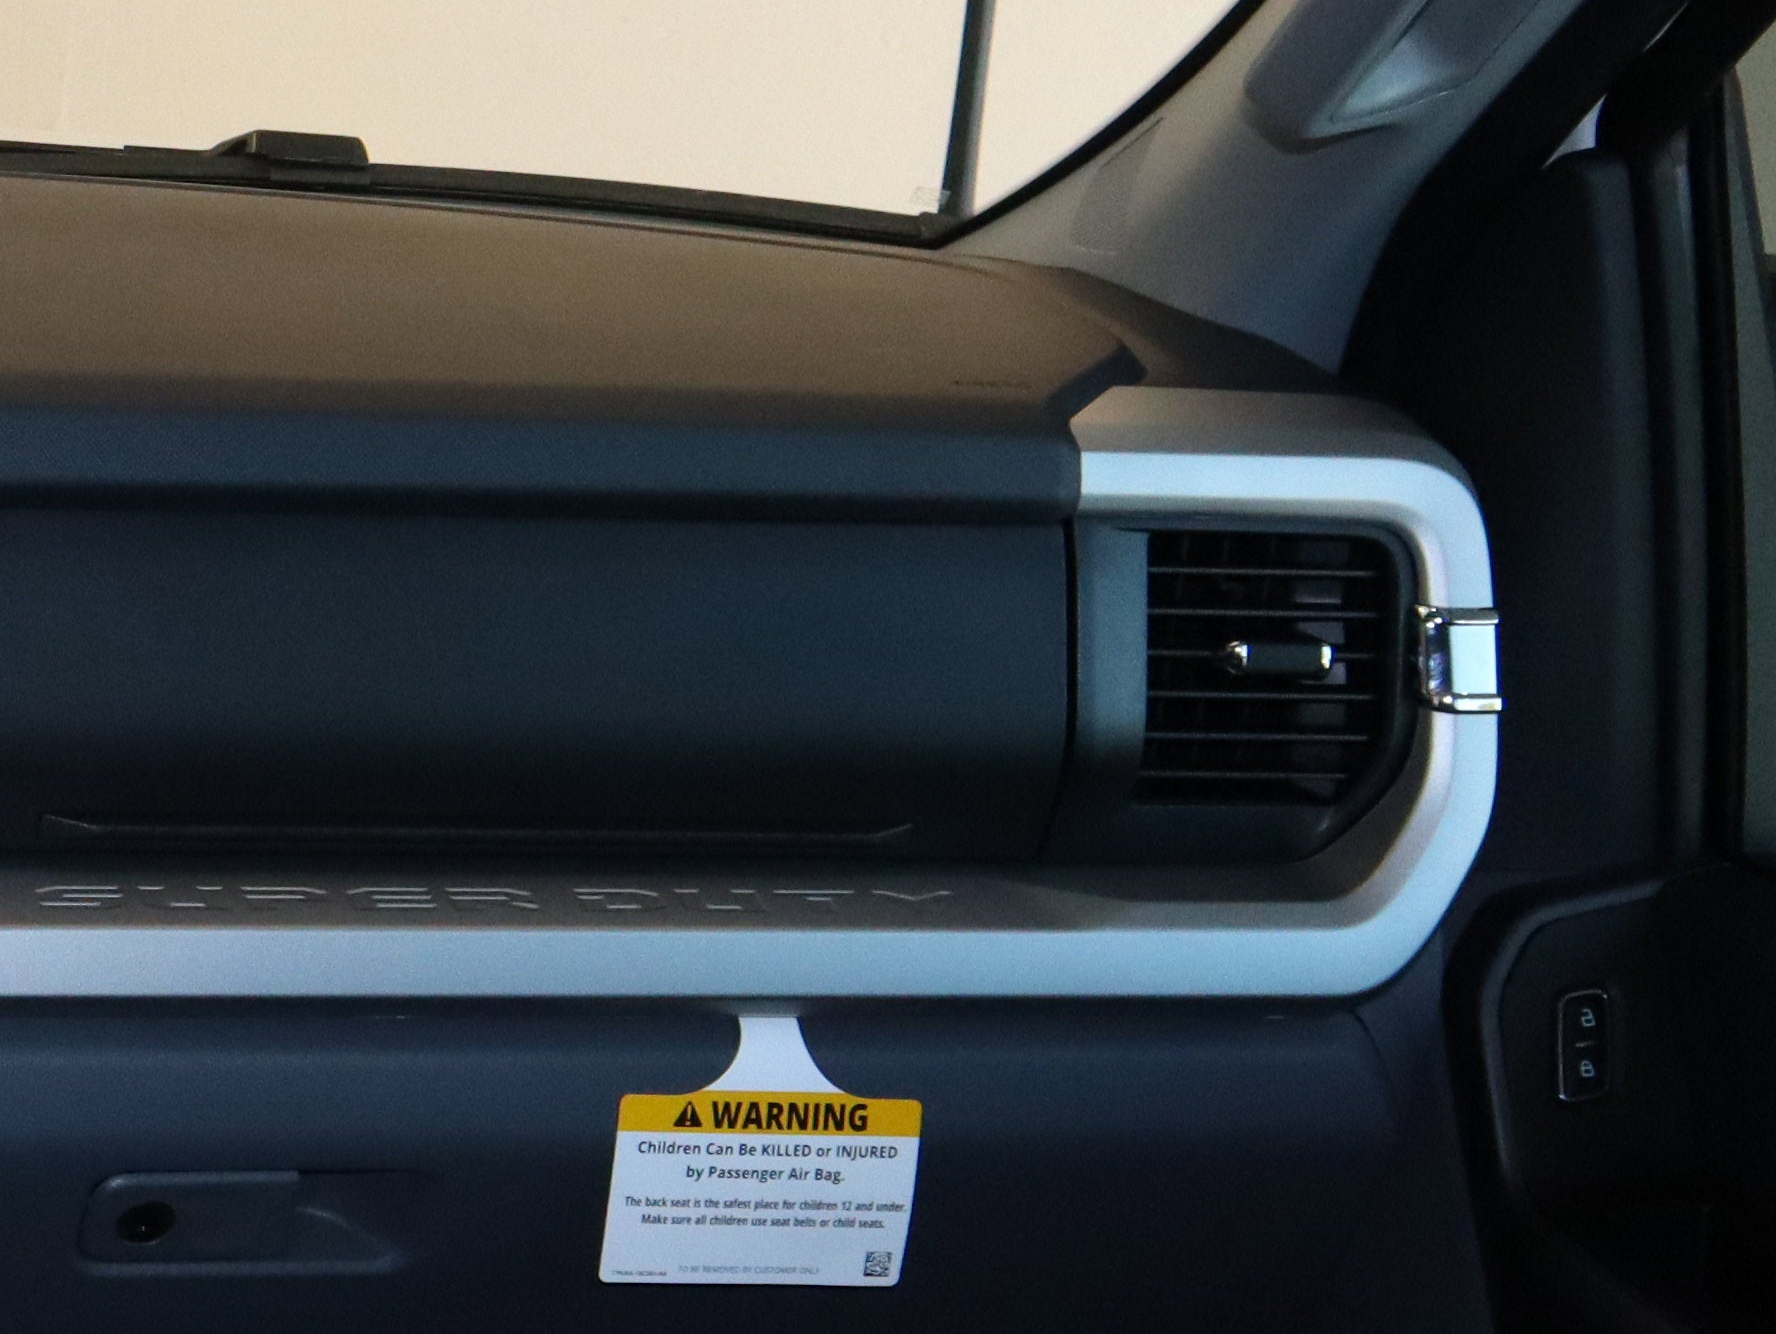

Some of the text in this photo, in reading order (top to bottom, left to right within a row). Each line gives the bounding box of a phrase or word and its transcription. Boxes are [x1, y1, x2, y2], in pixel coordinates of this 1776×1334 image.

[712, 1101, 869, 1133] WARNING
[638, 1141, 899, 1161] Children Can Be KILLED or INJURED
[685, 1165, 846, 1186] by Passenger Air Bag.
[624, 1196, 644, 1208] The
[645, 1196, 668, 1209] back
[670, 1198, 691, 1209] seat
[693, 1197, 702, 1209] is
[704, 1198, 721, 1210] the
[723, 1198, 752, 1210] safest
[754, 1199, 780, 1213] place
[782, 1199, 798, 1211] for
[799, 1200, 839, 1212] children
[841, 1201, 852, 1212] 12
[854, 1201, 874, 1212] and
[641, 1214, 669, 1226] Make
[670, 1216, 693, 1226] sure
[694, 1215, 708, 1227] all
[709, 1215, 749, 1227] children
[750, 1217, 769, 1227] use
[770, 1216, 791, 1228] seat
[793, 1216, 818, 1228] belts
[819, 1219, 831, 1229] or
[832, 1217, 856, 1229] child
